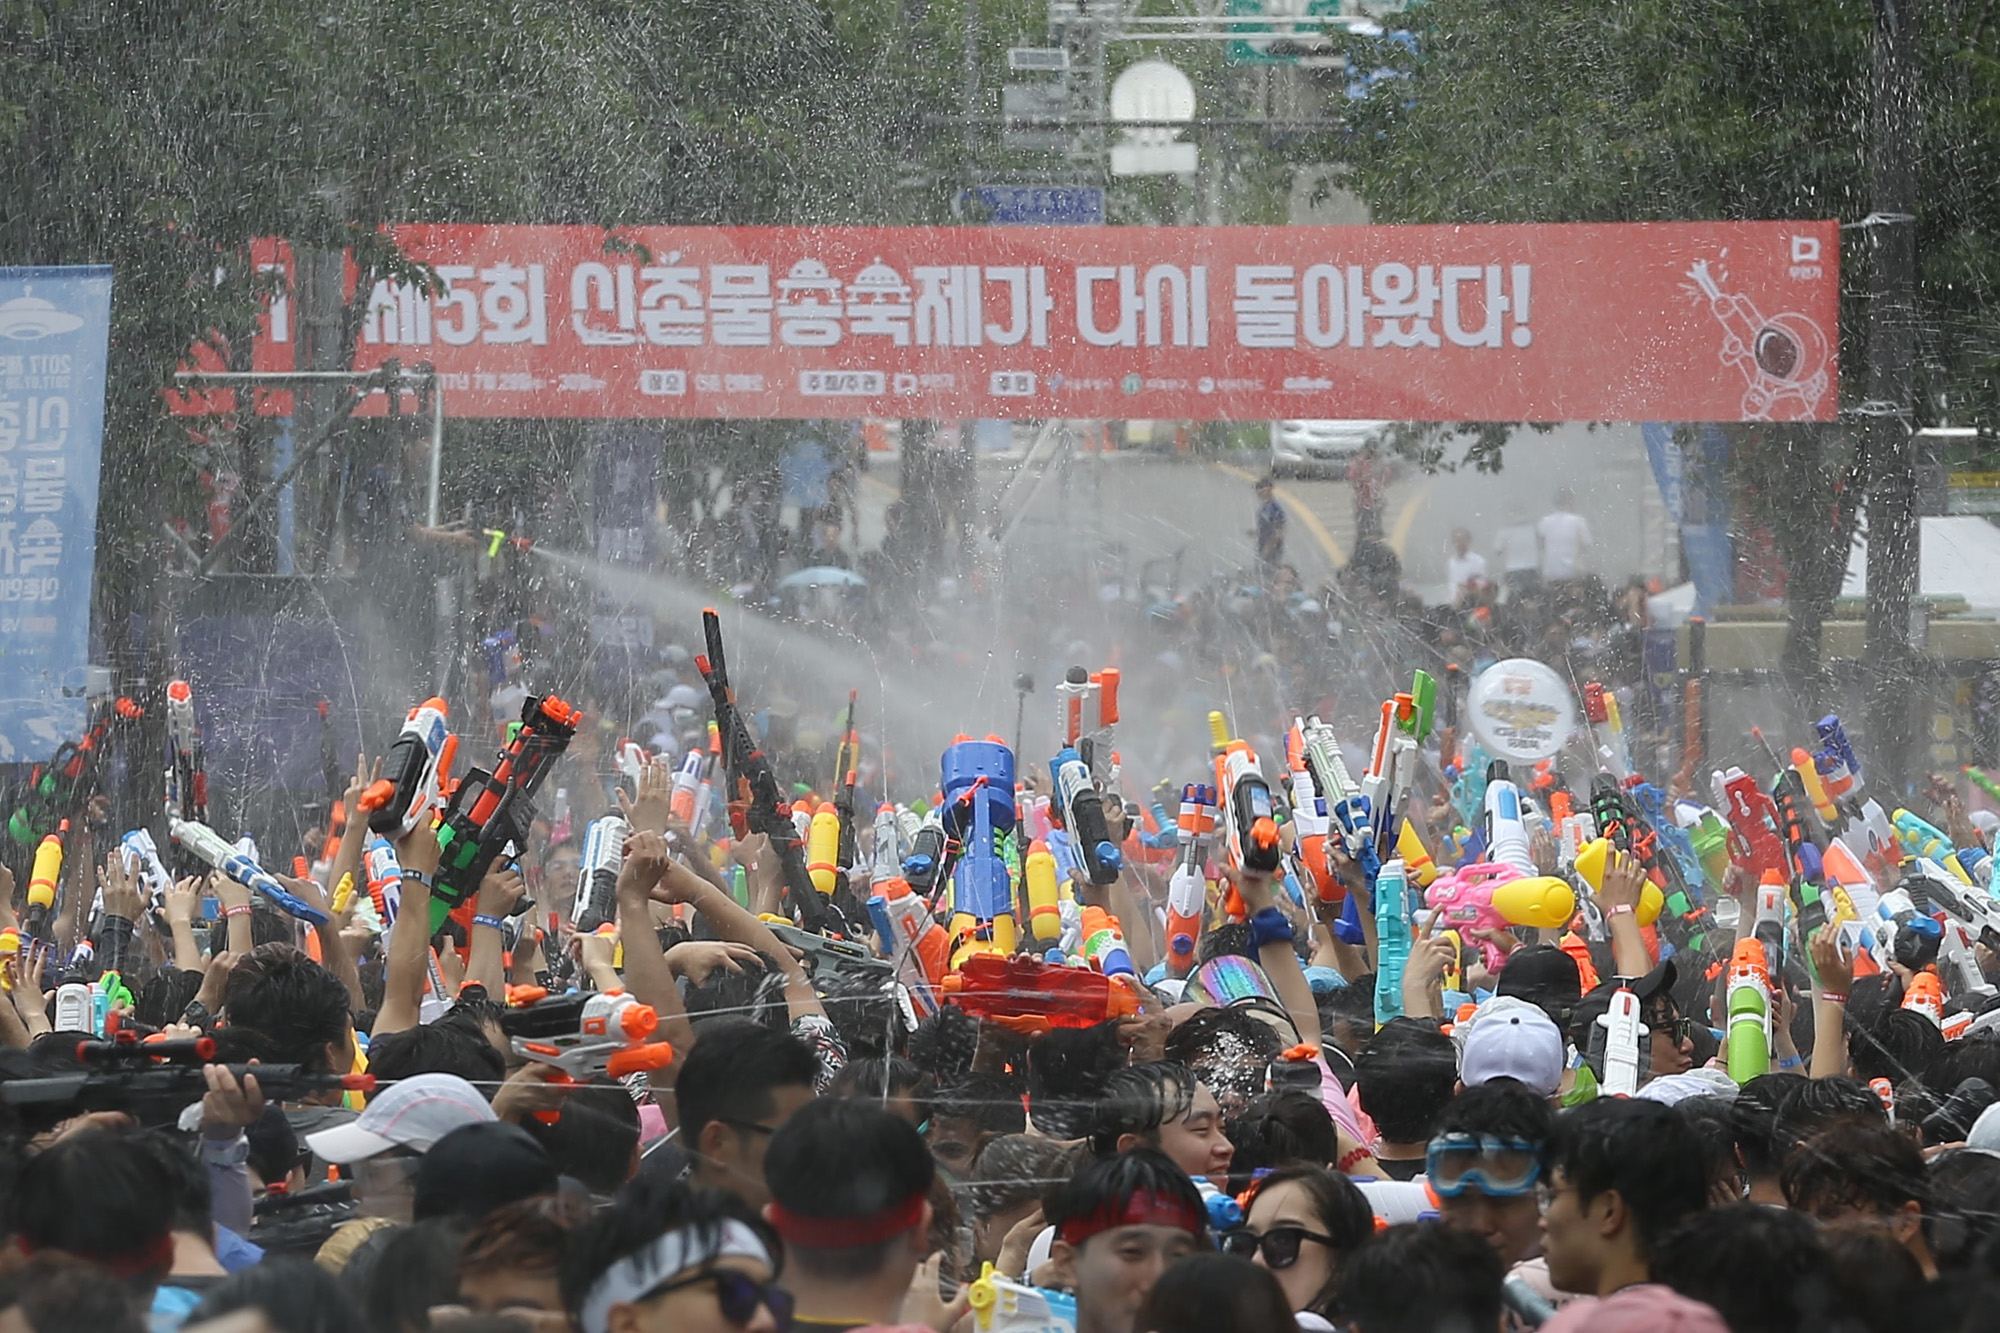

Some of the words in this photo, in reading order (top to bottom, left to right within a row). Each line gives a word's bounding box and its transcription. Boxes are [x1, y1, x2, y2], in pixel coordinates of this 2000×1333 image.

[570, 250, 1054, 348] 신촌물총축제가
[1075, 262, 1210, 349] 다시
[1233, 261, 1533, 349] 돌아왔다!
